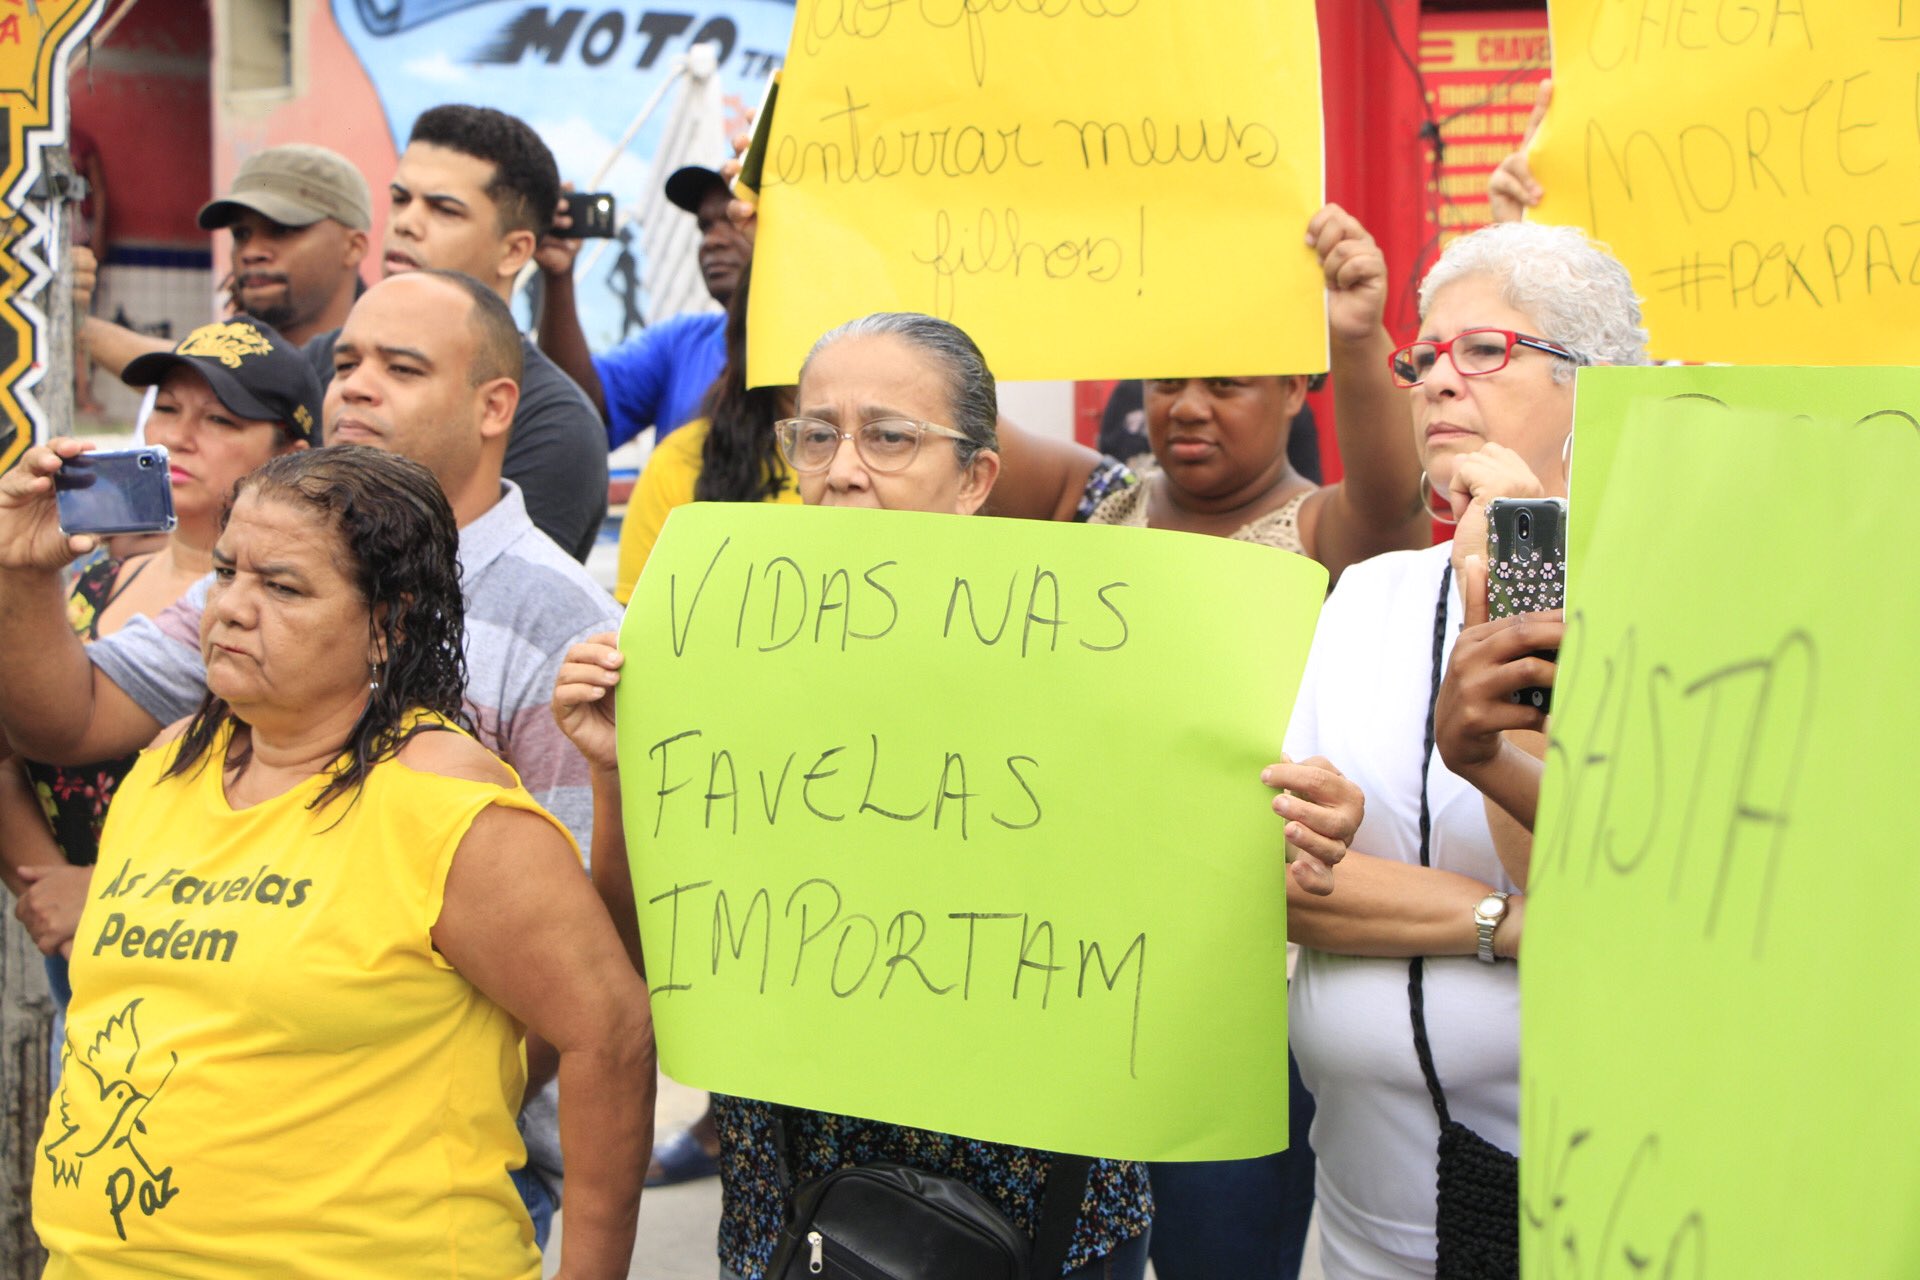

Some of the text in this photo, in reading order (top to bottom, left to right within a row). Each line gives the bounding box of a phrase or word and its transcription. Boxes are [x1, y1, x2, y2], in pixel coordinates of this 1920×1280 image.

[468, 8, 737, 69] MOTO
[760, 86, 1280, 186] enterrar meus
[1585, 70, 1888, 238] MORTE
[670, 536, 1131, 658] VIDAS NAS
[648, 729, 1042, 841] FAVELAS
[98, 858, 313, 908] As Favelas
[92, 912, 239, 962] Pedem
[648, 878, 1146, 1079] IMPORTAM
[105, 1166, 180, 1241] Paz
